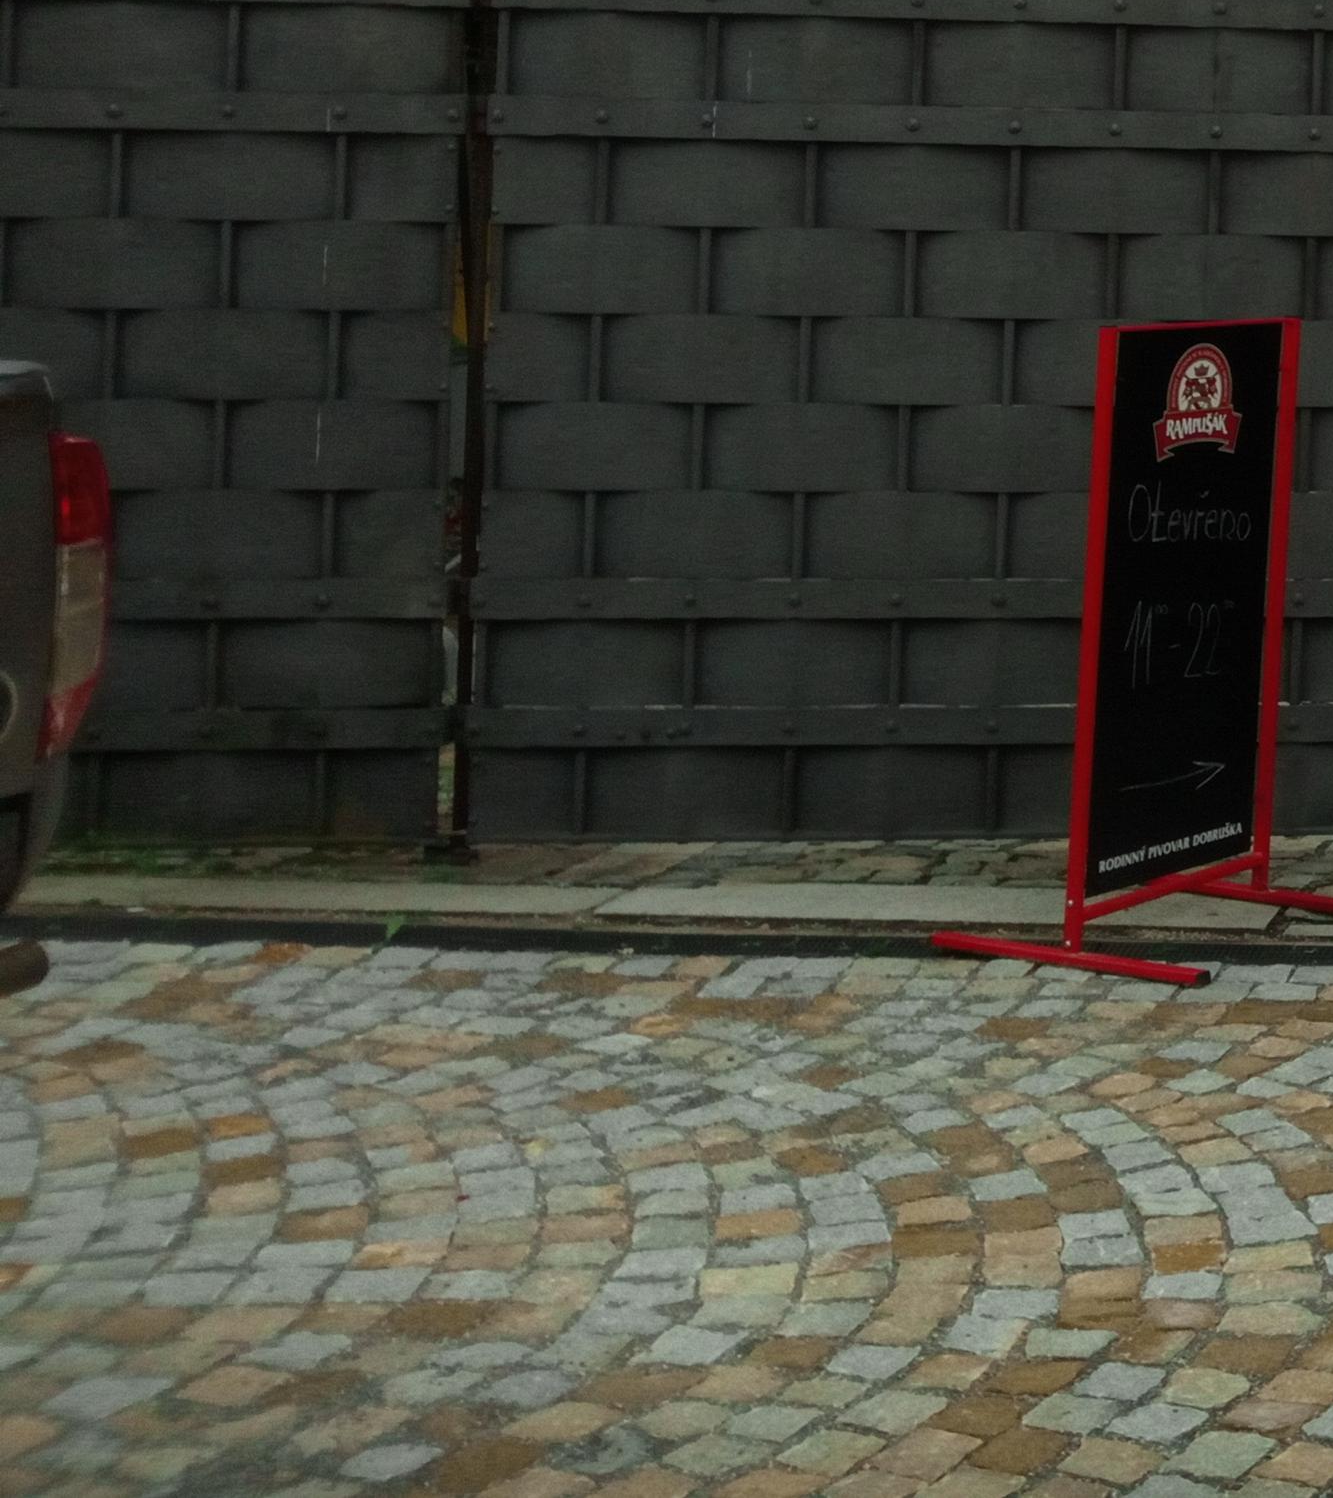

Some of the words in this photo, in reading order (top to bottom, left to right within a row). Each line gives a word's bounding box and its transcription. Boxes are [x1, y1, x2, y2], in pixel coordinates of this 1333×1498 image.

[1166, 411, 1228, 440] RAMPUŠÁK
[1098, 845, 1146, 874] RODINNÝ
[1147, 836, 1191, 860] PIVOVAR
[1192, 822, 1243, 848] DOBRUŠKA
